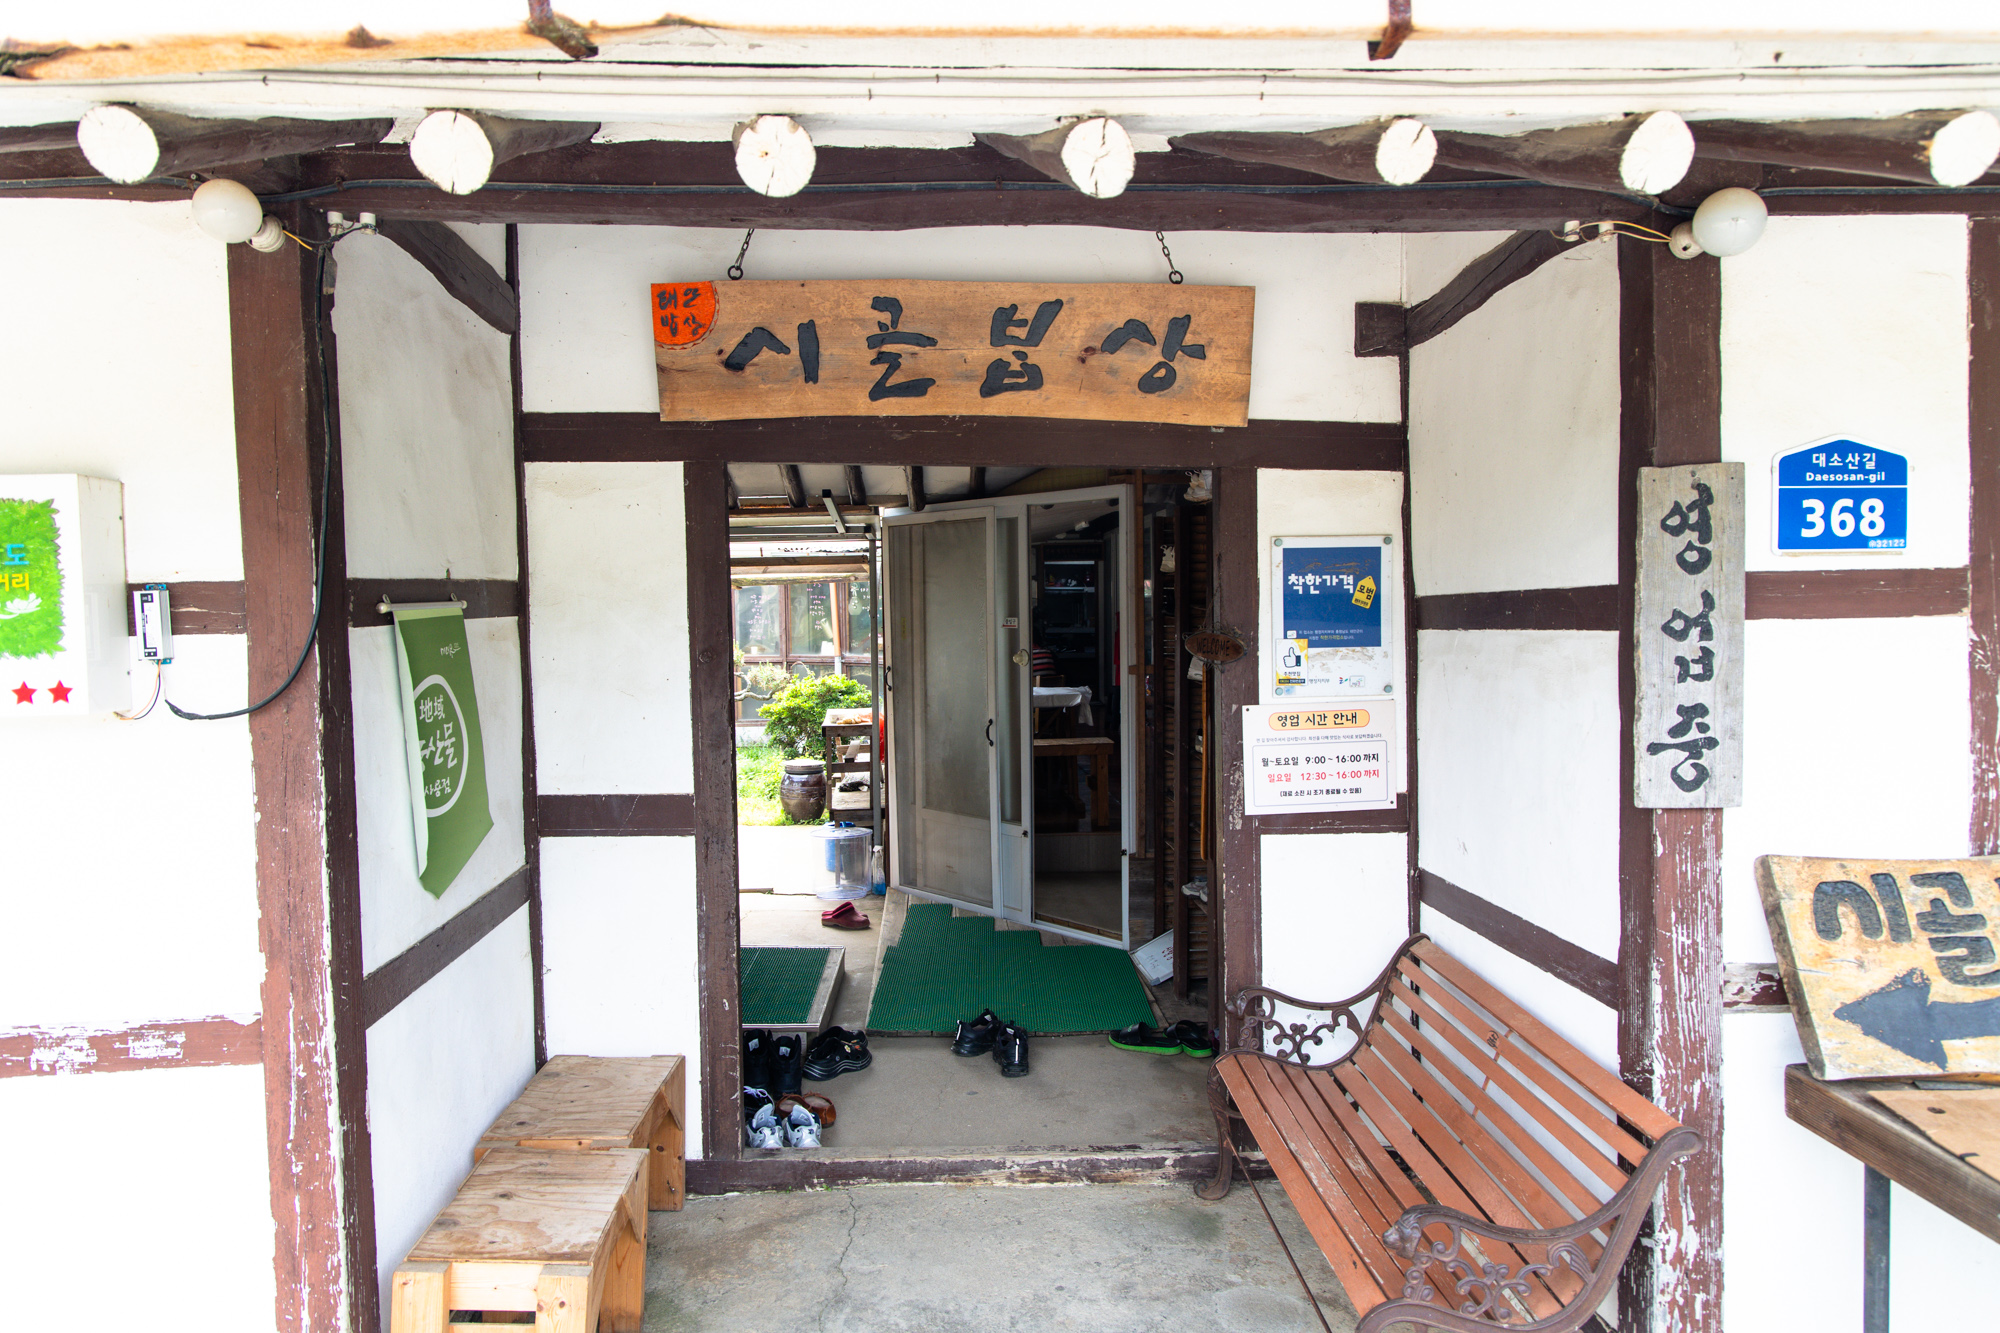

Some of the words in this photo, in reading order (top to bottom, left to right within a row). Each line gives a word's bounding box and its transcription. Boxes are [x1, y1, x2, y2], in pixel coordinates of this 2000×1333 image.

[1812, 452, 1876, 470] 대소산길
[1805, 471, 1886, 483] Daesosan-gil
[1800, 498, 1886, 538] 368
[1287, 572, 1354, 596] 착한가격
[1356, 584, 1375, 601] 모범
[1196, 636, 1231, 657] WELCOME
[1646, 482, 1720, 794] 영업중
[419, 694, 446, 723] 地域
[1277, 713, 1301, 728] 영업
[1305, 712, 1328, 726] 시간
[1333, 711, 1358, 726] 안내
[1261, 756, 1299, 768] 월~토요일
[1304, 755, 1326, 765] 9:00
[1335, 754, 1362, 764] 16:00
[1363, 752, 1379, 763] 까지
[1267, 773, 1292, 784] 일요일
[1300, 771, 1327, 781] 12:30
[1336, 770, 1362, 780] 16:00
[1363, 768, 1380, 779] 까지
[1279, 790, 1293, 798] (재료
[1294, 789, 1305, 797] 소진
[1325, 788, 1341, 796] 종료될
[1342, 787, 1348, 795] 수
[1348, 787, 1362, 795] 있음)
